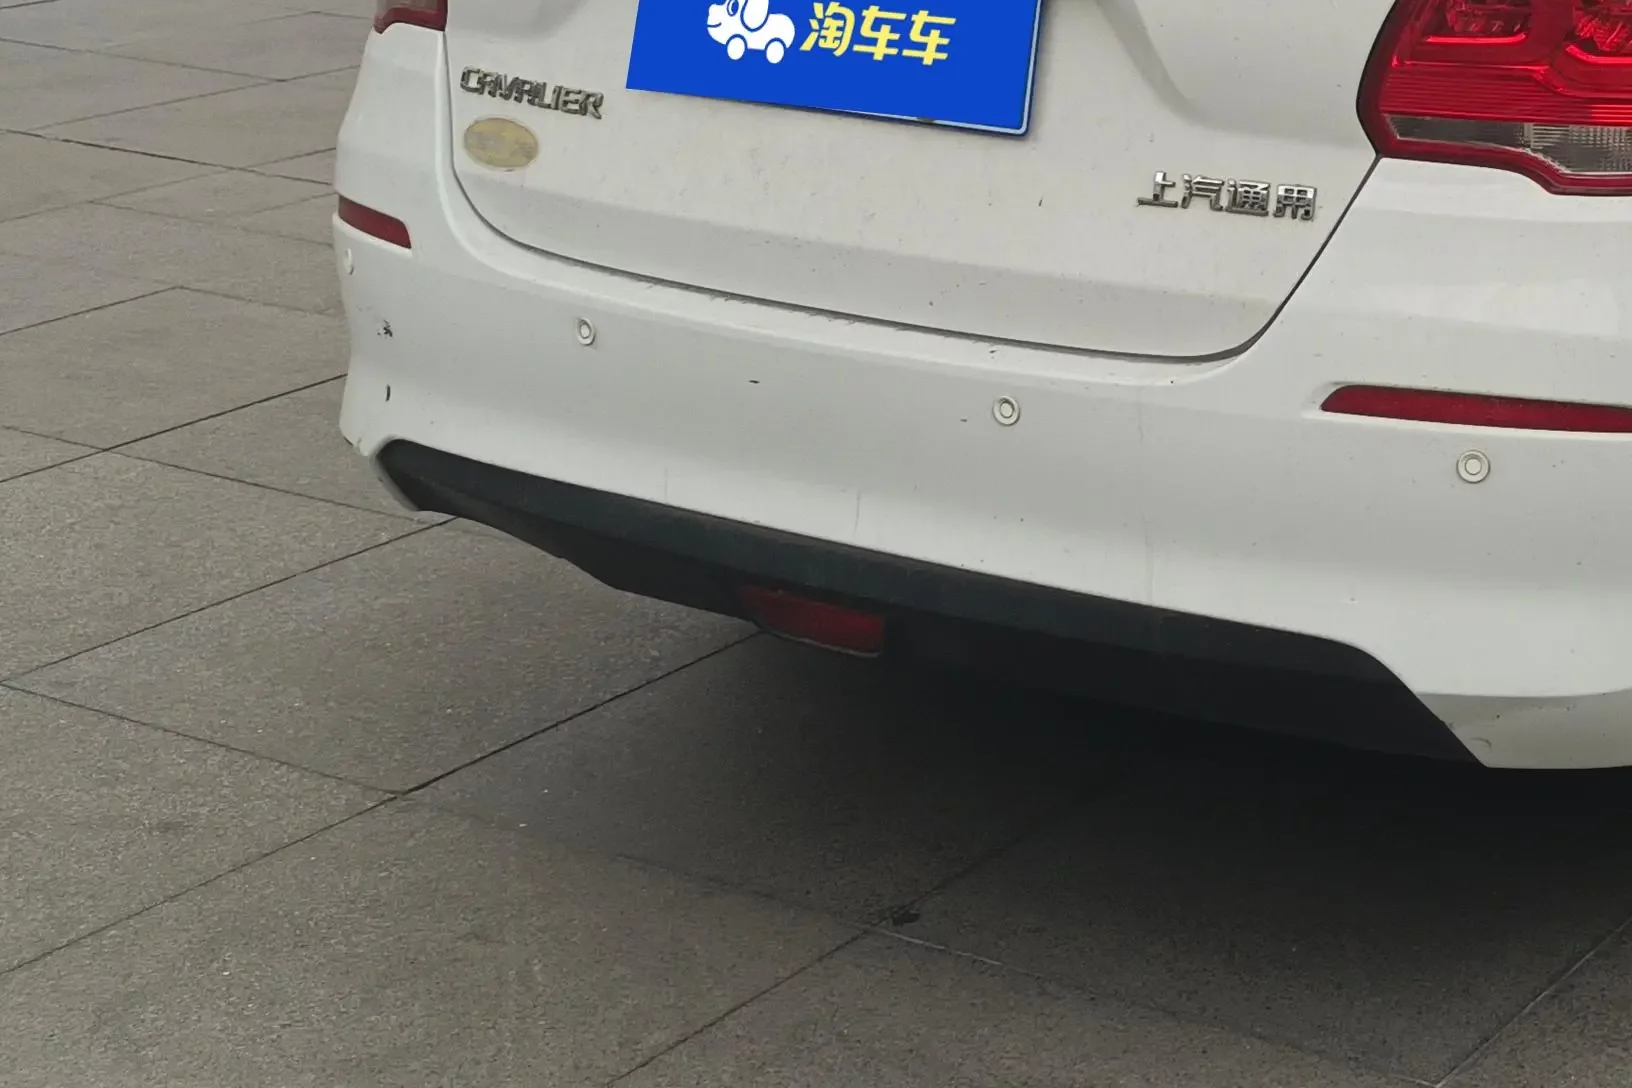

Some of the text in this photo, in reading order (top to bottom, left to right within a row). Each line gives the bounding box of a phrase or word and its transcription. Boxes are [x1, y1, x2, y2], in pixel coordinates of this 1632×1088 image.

[460, 66, 605, 120] CAVALIER
[1136, 169, 1318, 221] 上汽通用
